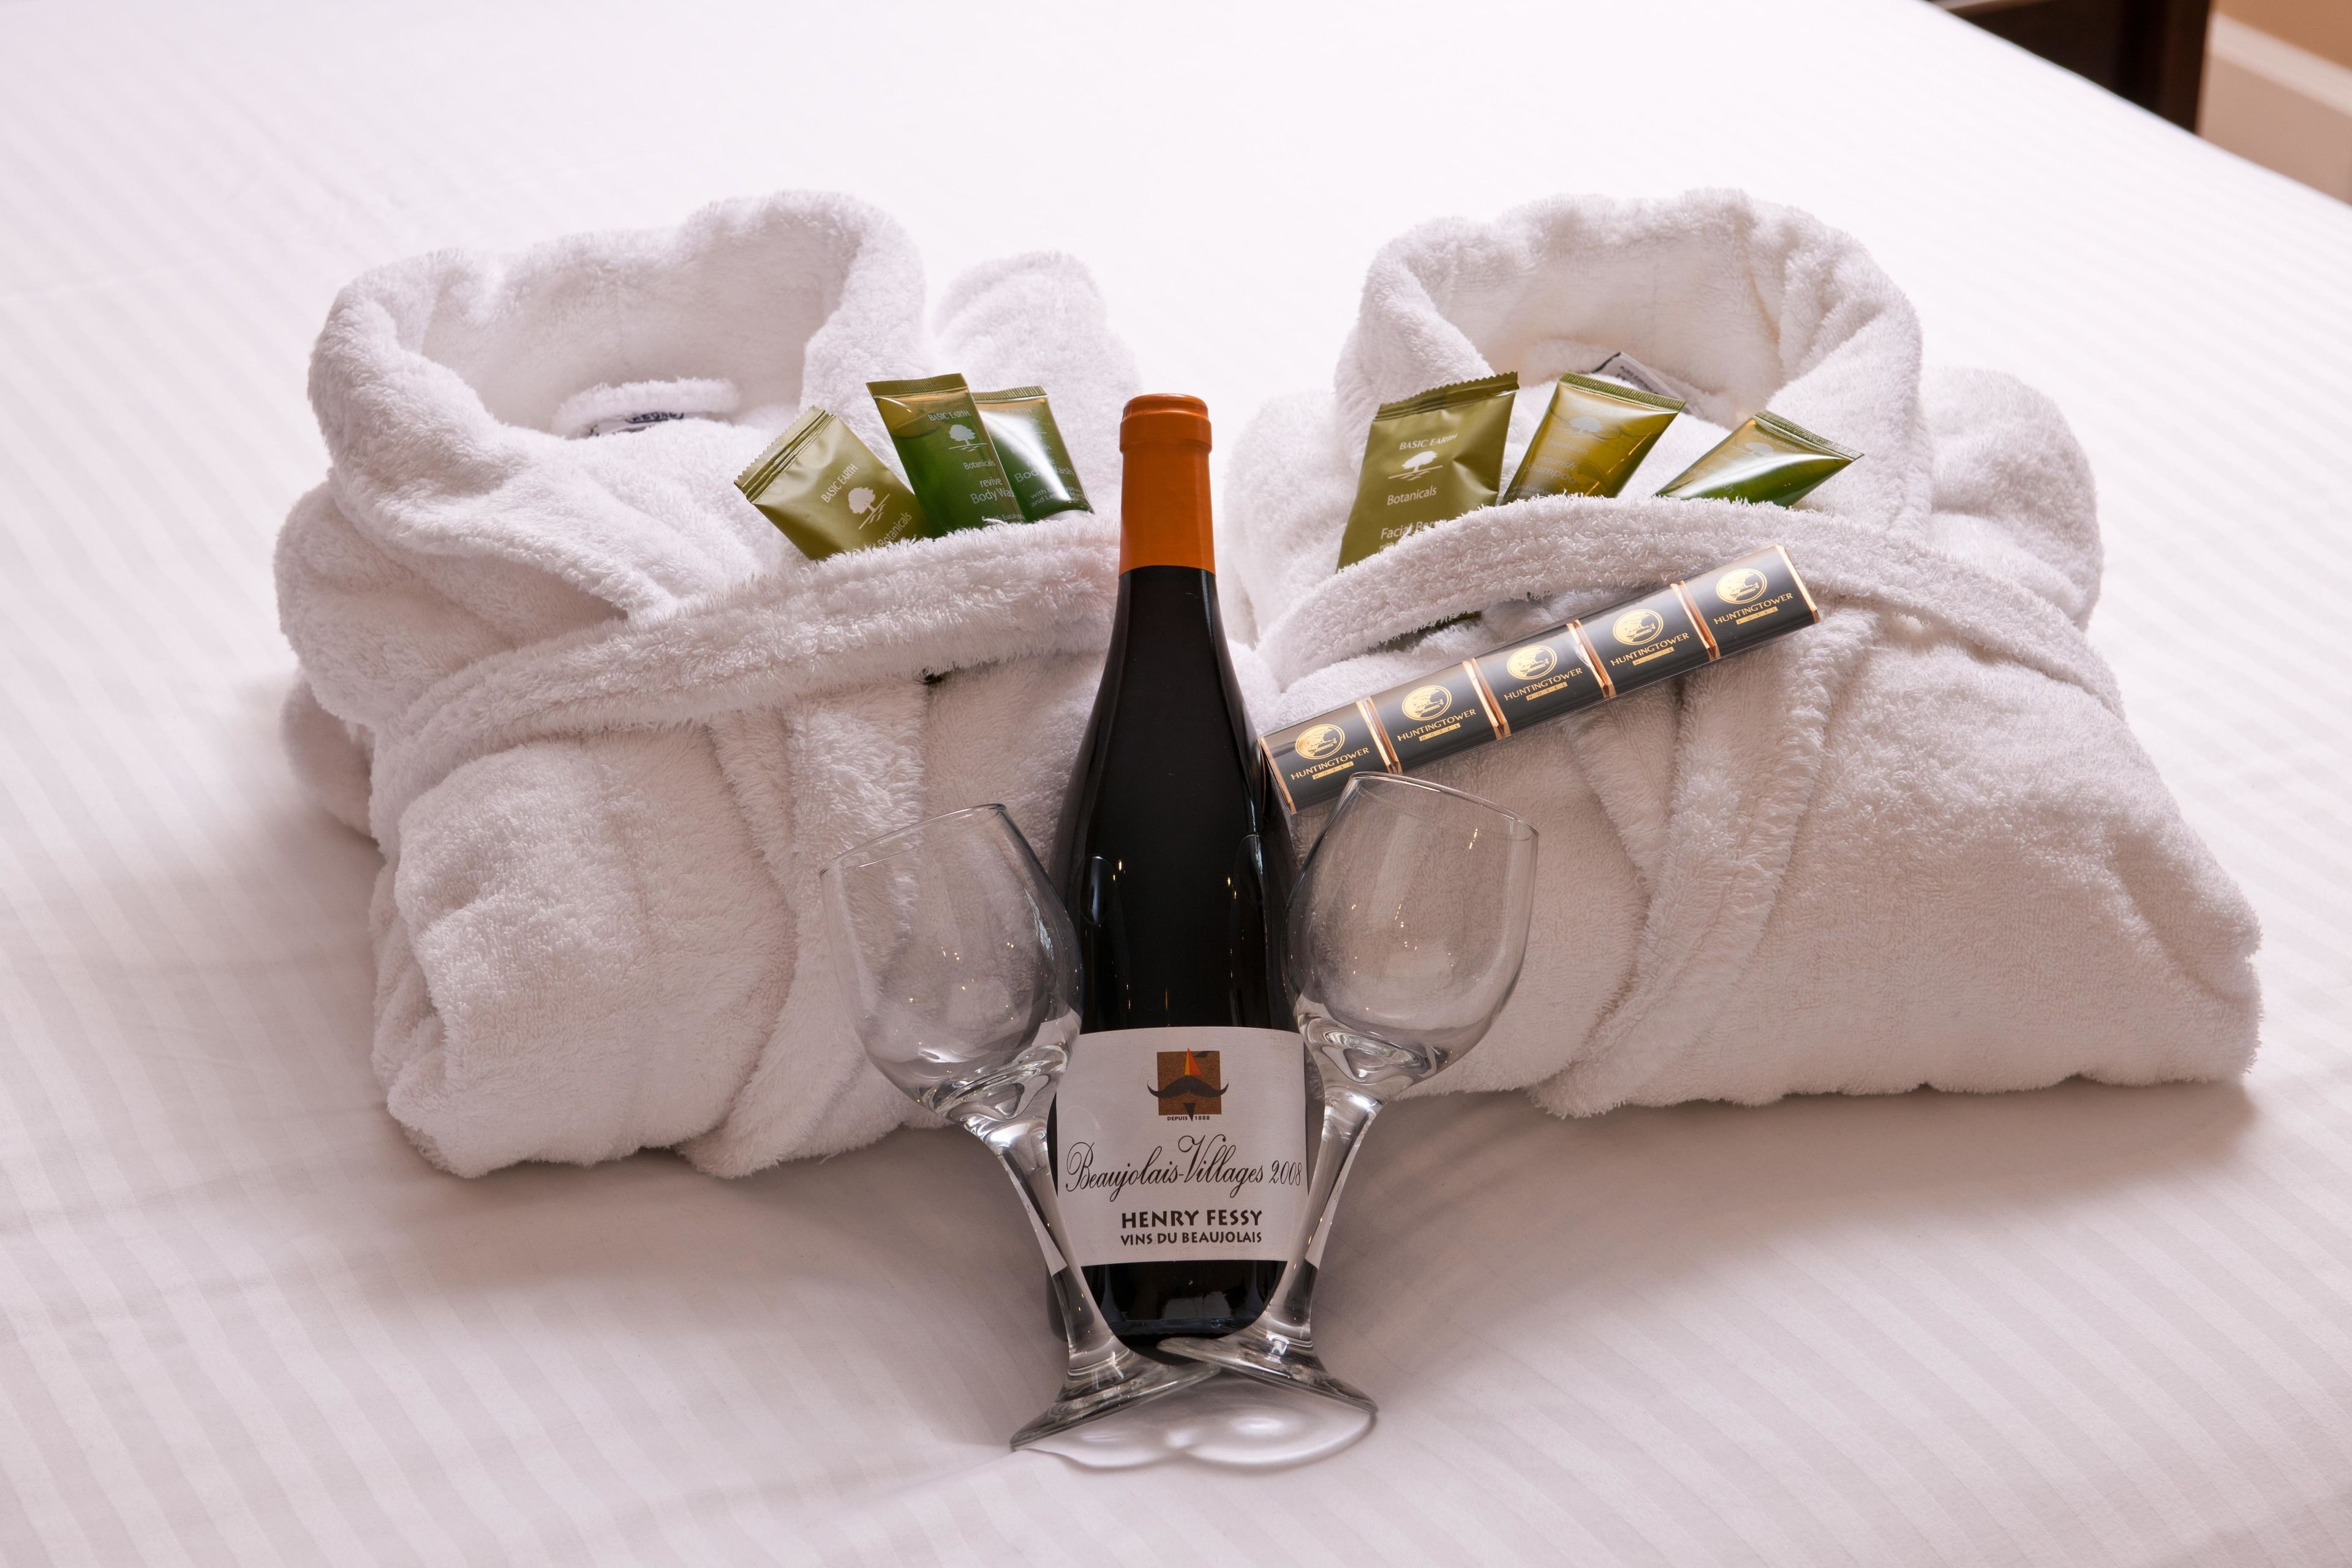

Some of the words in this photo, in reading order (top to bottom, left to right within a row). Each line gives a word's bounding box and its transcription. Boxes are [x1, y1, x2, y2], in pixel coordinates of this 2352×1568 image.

[928, 412, 949, 421] BASIC
[949, 410, 971, 419] EARTH
[1399, 439, 1428, 450] BASIC
[1430, 433, 1458, 446] EARTH
[963, 459, 996, 470] Botanicals
[1053, 466, 1074, 477] ash
[1538, 455, 1576, 470] nourish
[821, 481, 842, 503] BASIC
[837, 463, 858, 485] EARTH
[979, 477, 1003, 488] revive
[1524, 462, 1578, 484] Shampoo
[970, 489, 997, 504] Body
[1030, 488, 1047, 499] with
[1031, 494, 1045, 507] and
[1387, 485, 1437, 505] Botanicals
[877, 511, 912, 547] Botanicals
[1714, 592, 1793, 625] HUNTINGTOWER
[1610, 632, 1690, 666] HUNTINGTOWER
[1504, 668, 1583, 701] HUNTINGTOWER
[1396, 709, 1477, 741] HUNTINGTOWER
[1290, 747, 1370, 780] HUNTINGTOWER
[1066, 1134, 1264, 1202] Beaujolais-Villages
[1269, 1160, 1302, 1186] 2008
[1121, 1210, 1199, 1229] HENRY
[1207, 1209, 1262, 1226] FESSY
[1120, 1233, 1153, 1245] VINS
[1157, 1233, 1177, 1244] DU
[1182, 1231, 1262, 1244] BEAUJOLAIS
